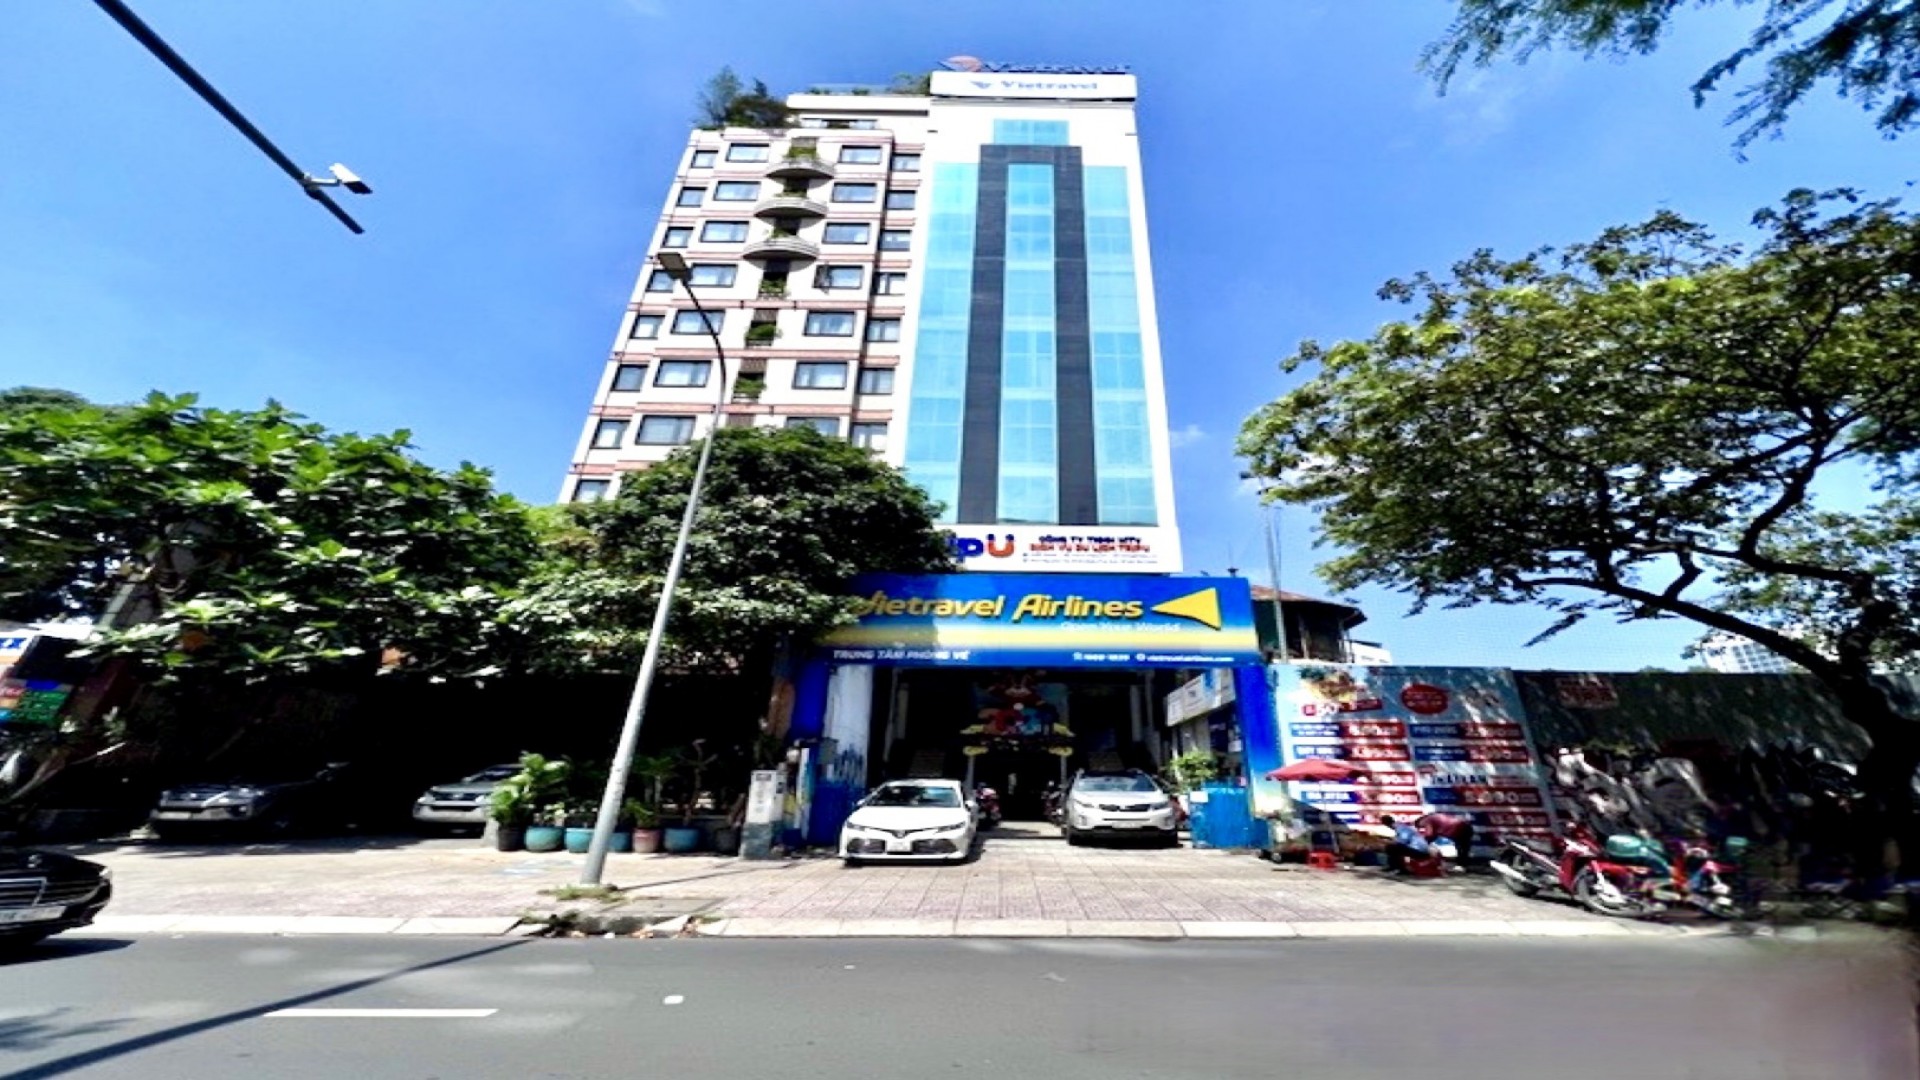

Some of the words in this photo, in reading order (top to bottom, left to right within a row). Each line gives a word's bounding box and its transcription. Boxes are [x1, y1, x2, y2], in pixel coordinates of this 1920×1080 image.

[1000, 80, 1098, 90] Vietravel
[1012, 594, 1144, 621] Airlines
[833, 650, 875, 659] TRUNG
[877, 648, 905, 659] TÂM
